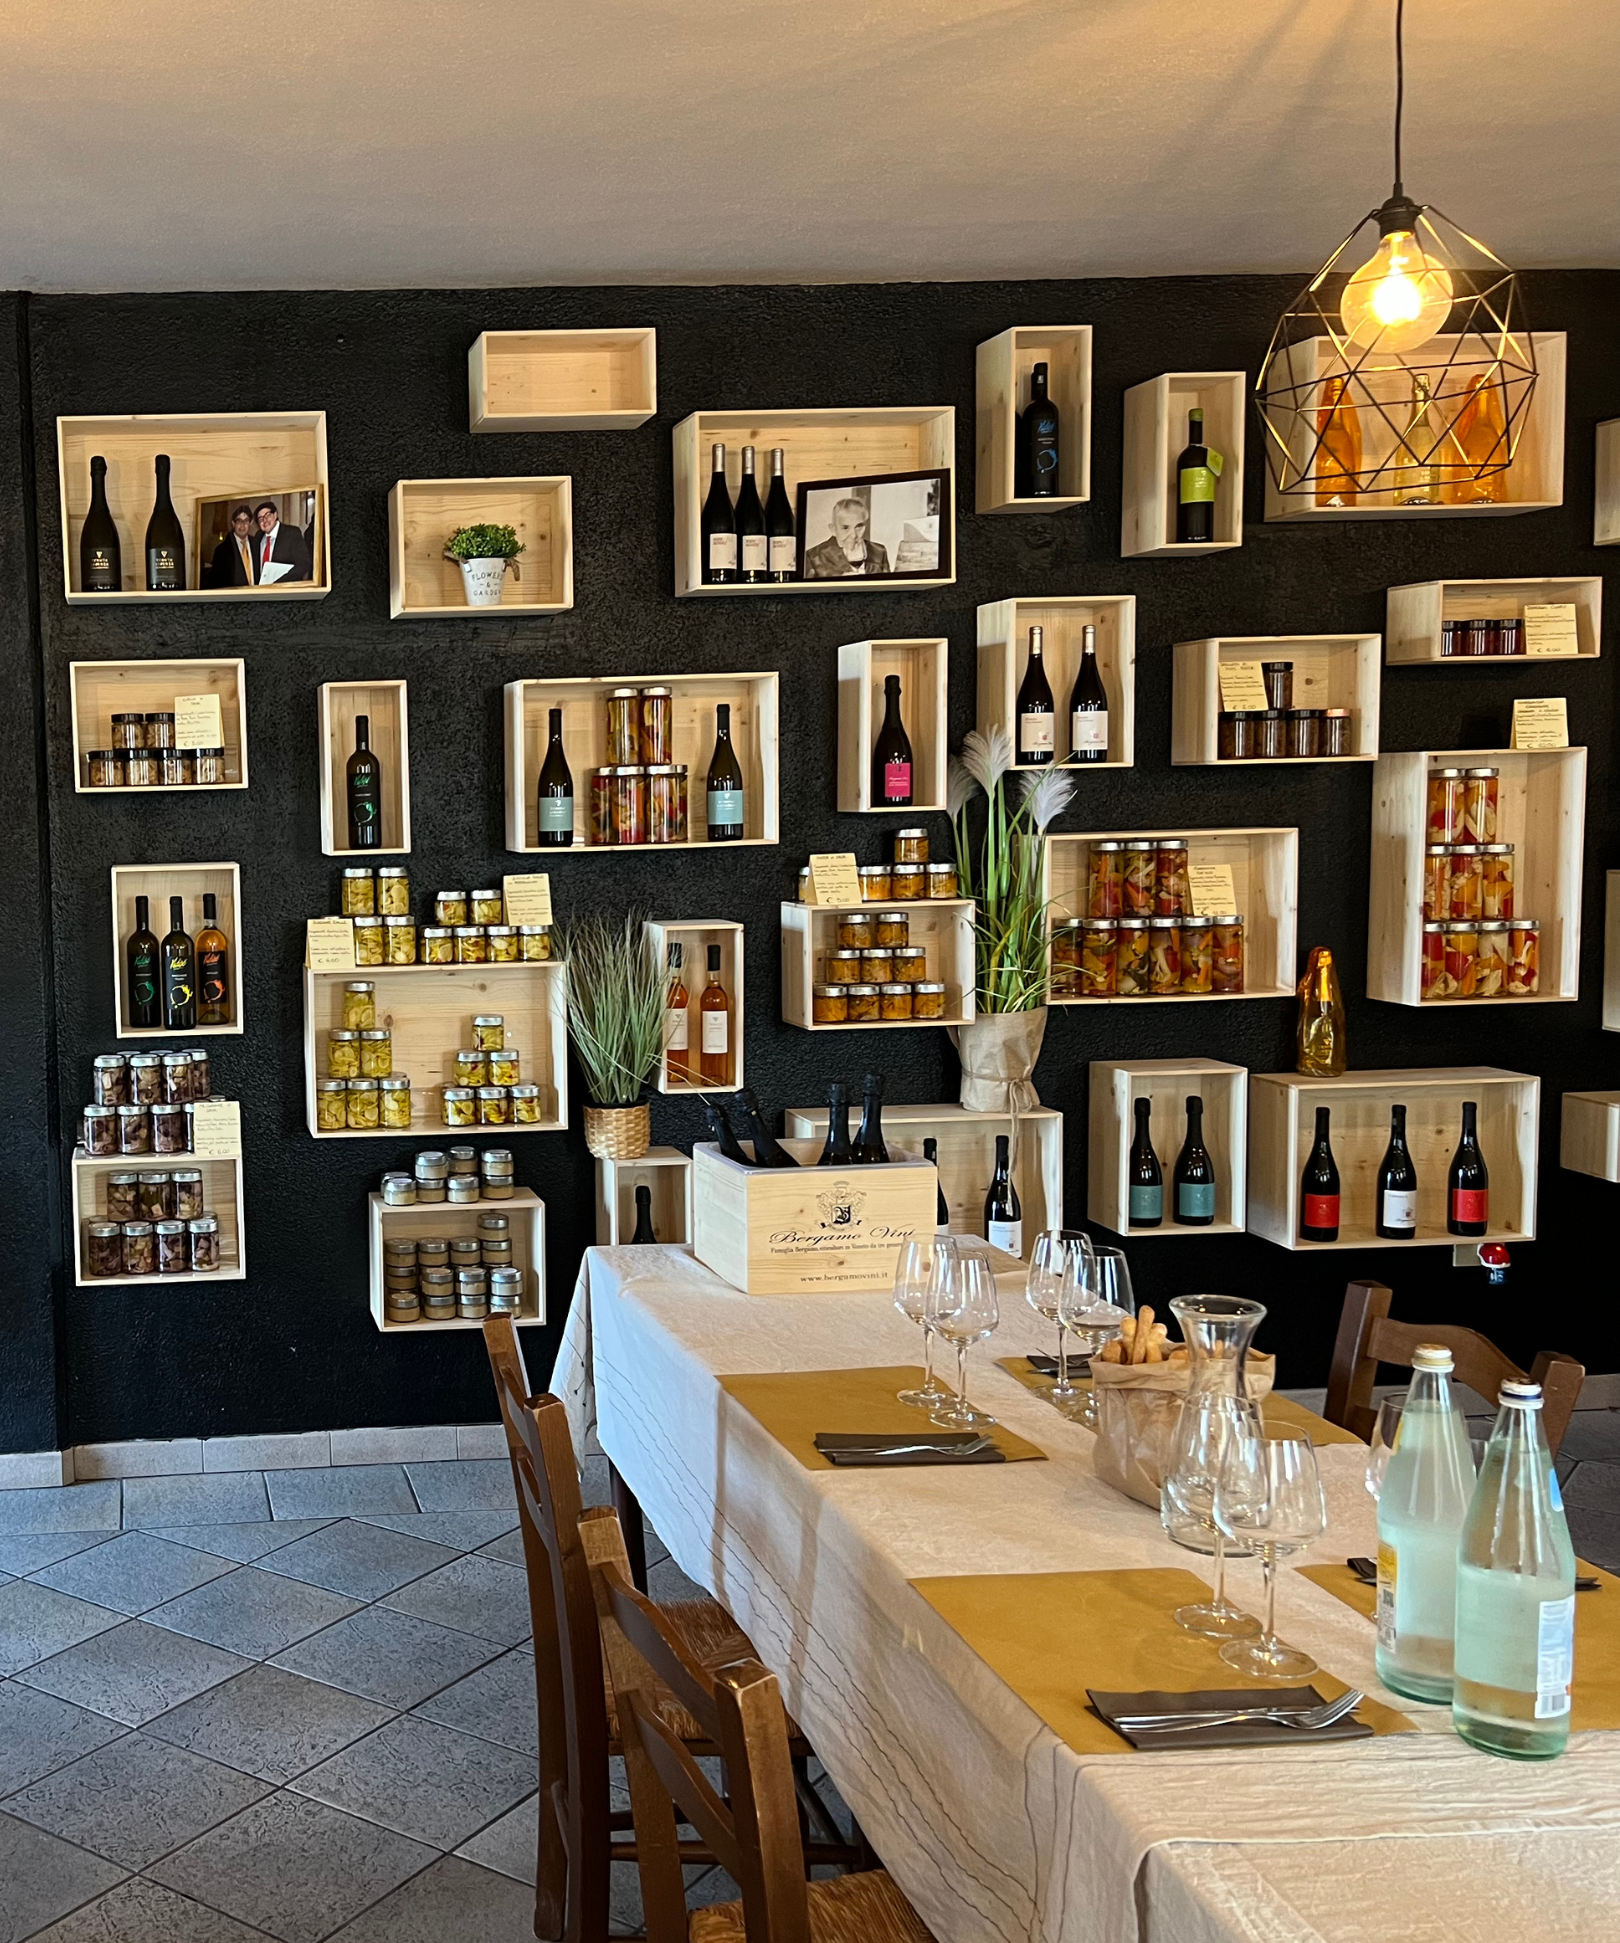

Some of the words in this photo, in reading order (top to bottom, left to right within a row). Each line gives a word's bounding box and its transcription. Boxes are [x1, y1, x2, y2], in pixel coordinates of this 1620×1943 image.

[769, 1230, 861, 1247] Bergamo
[870, 1223, 916, 1239] Vini
[800, 1272, 888, 1282] www.bergamovini.it
